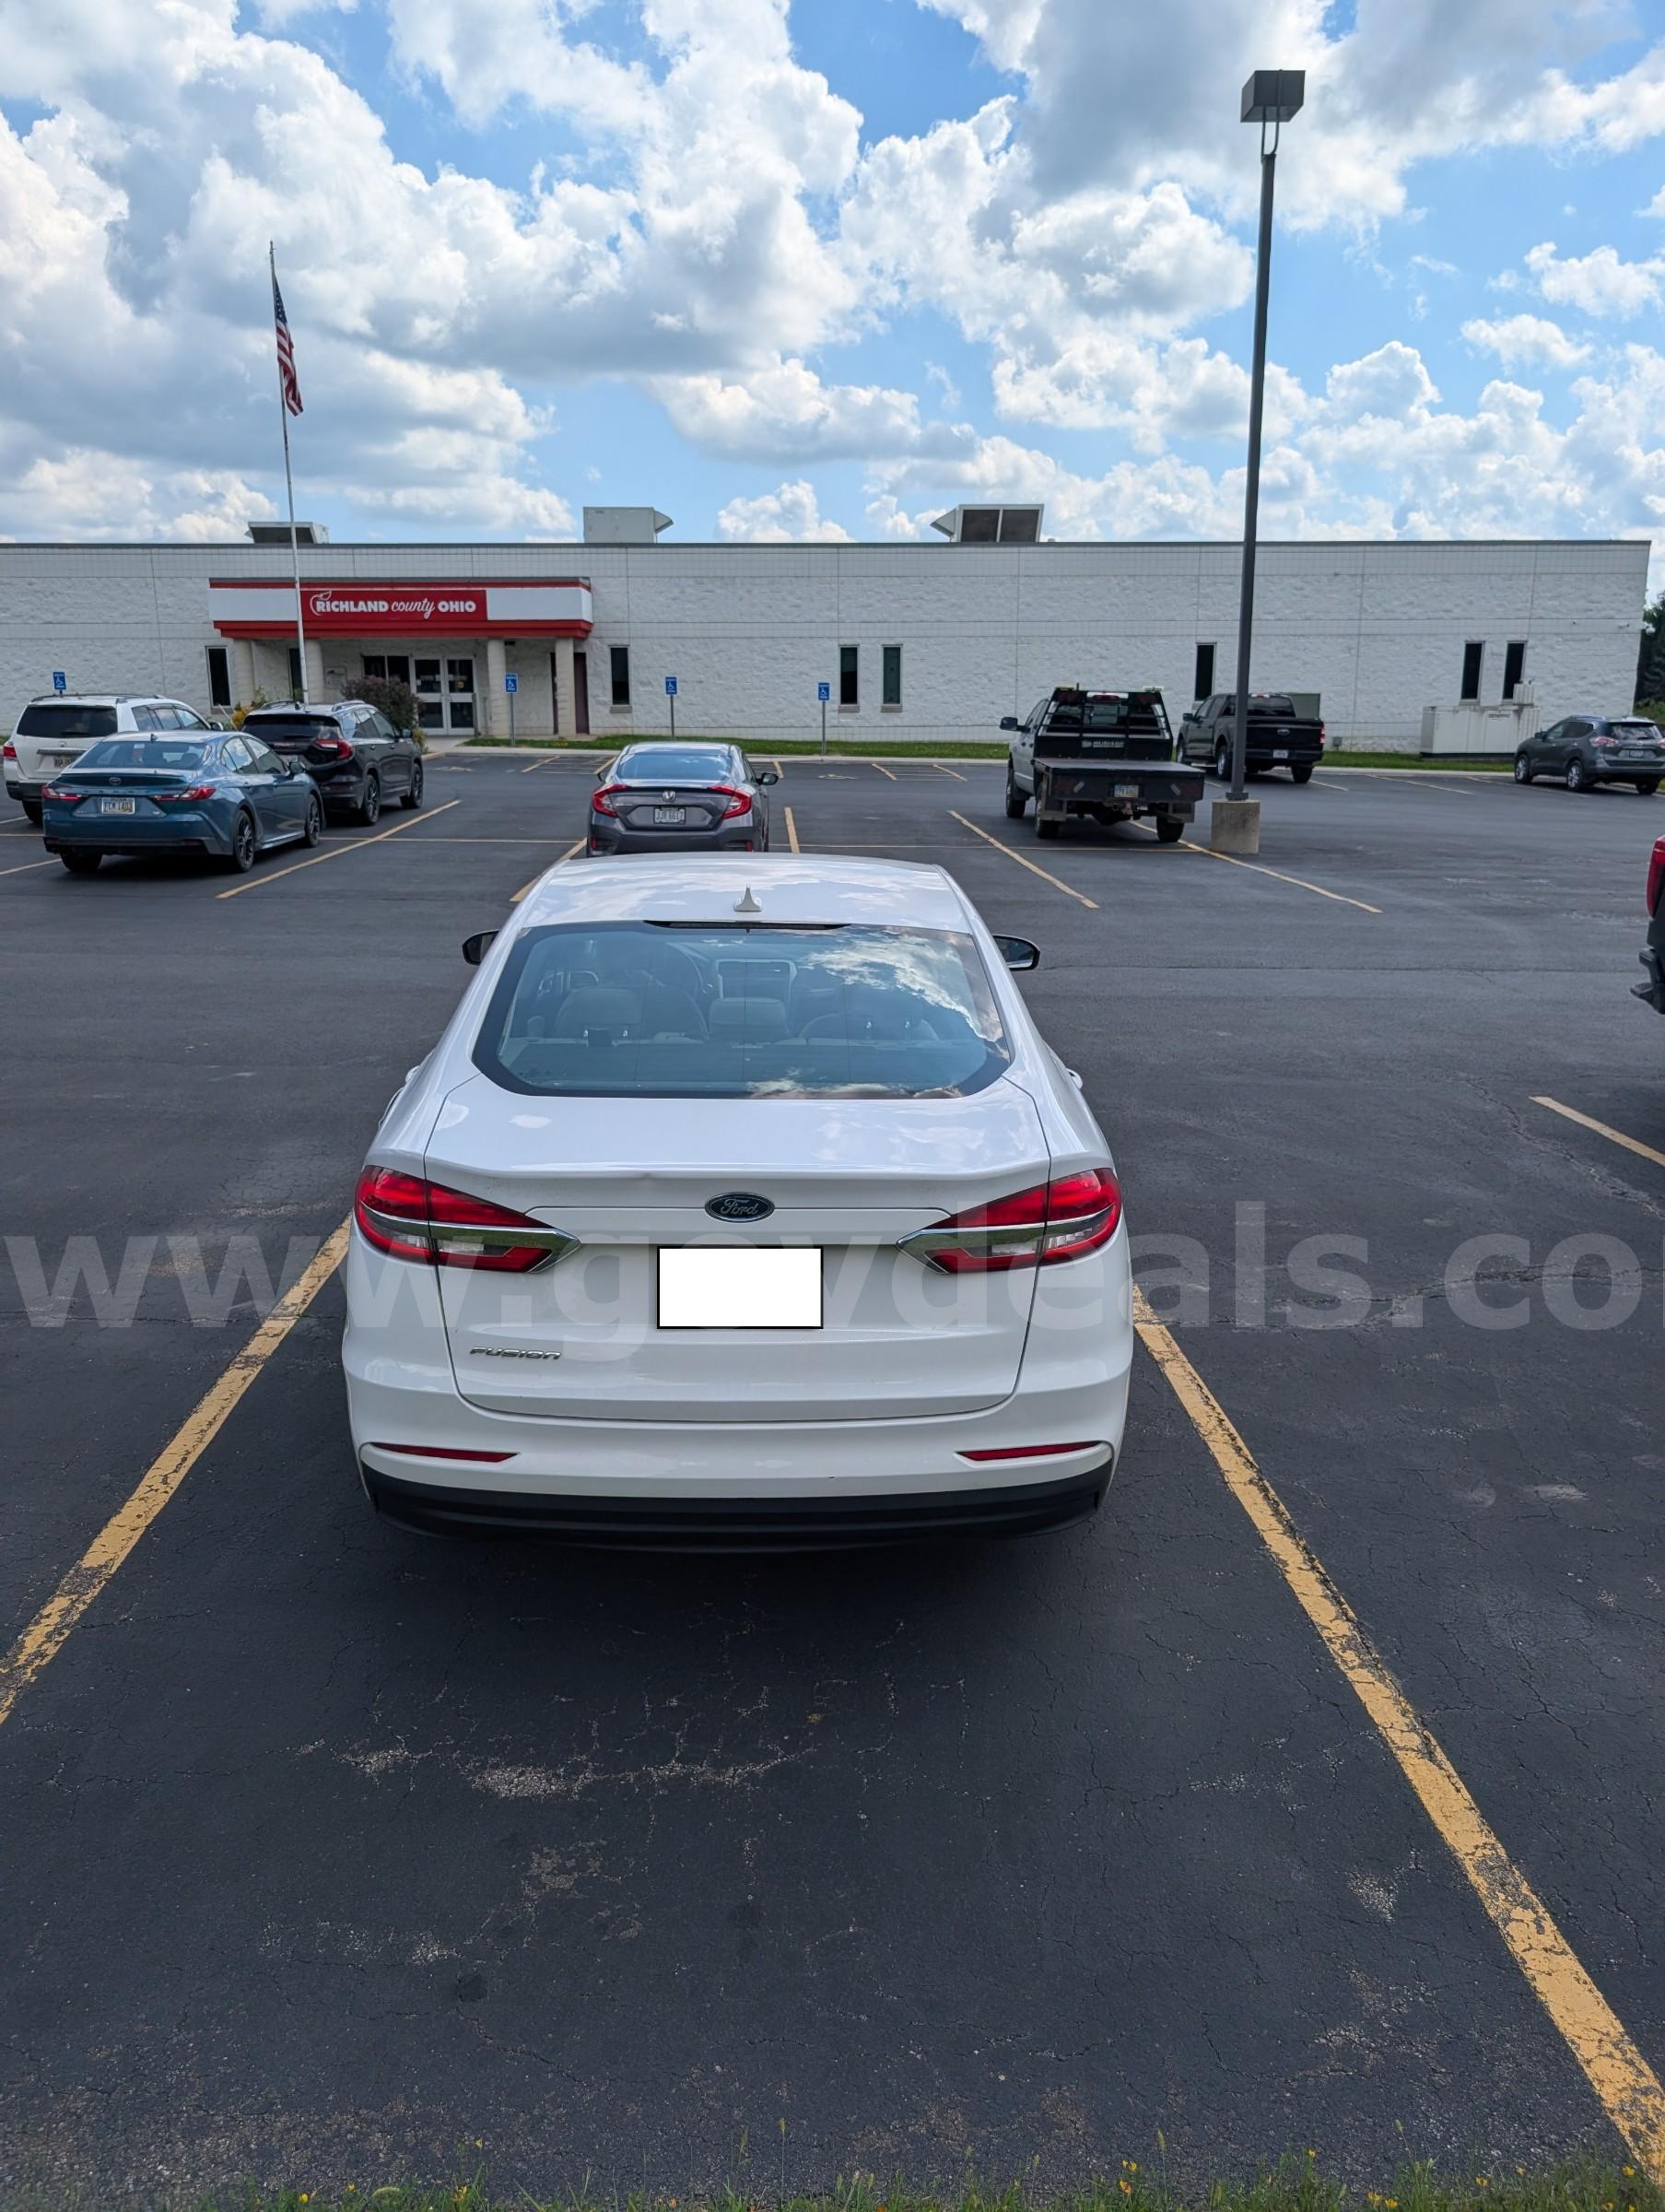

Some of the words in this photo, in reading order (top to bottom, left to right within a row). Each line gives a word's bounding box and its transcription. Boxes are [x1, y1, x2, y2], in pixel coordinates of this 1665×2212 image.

[316, 601, 389, 612] RICHLAND
[391, 598, 435, 619] county
[438, 601, 476, 612] OHIO
[470, 1347, 561, 1359] FUSION
